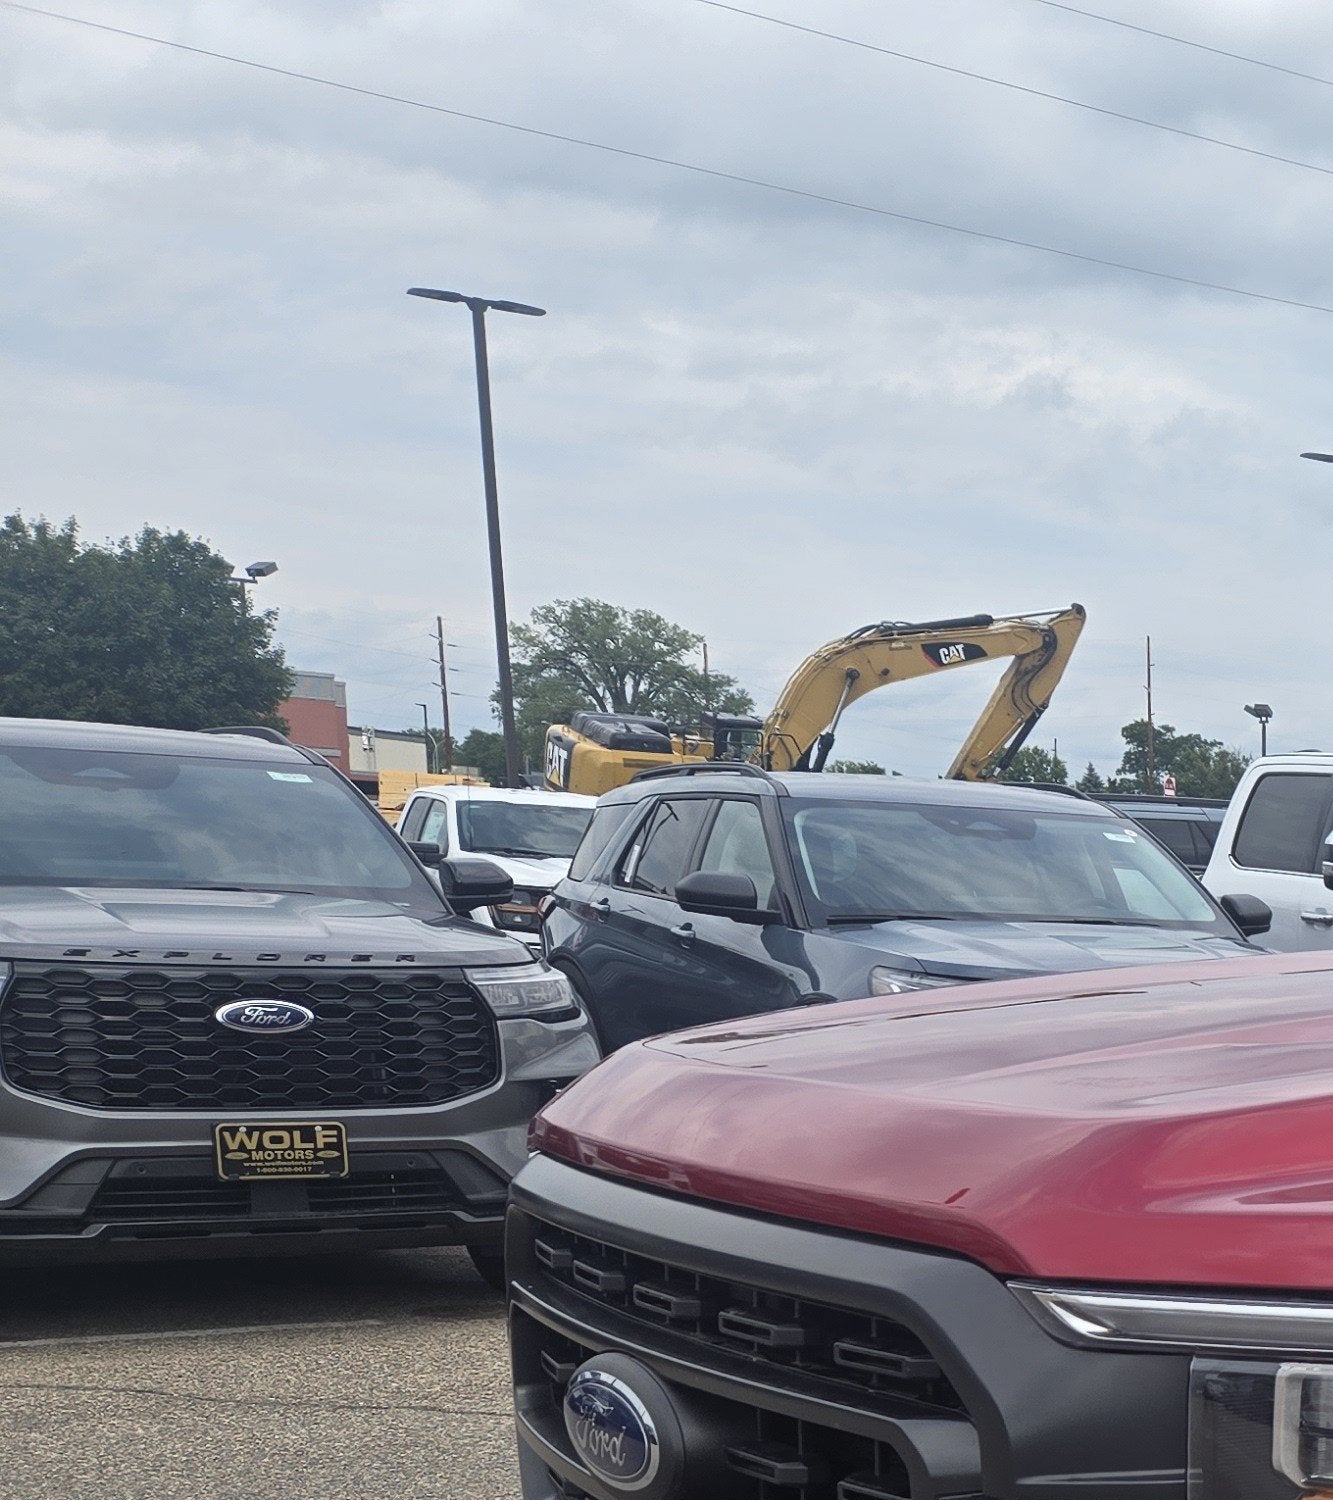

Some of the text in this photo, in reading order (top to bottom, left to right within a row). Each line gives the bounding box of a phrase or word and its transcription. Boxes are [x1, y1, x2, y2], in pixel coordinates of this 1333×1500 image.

[939, 644, 966, 664] CAT
[546, 741, 568, 788] CAT
[62, 948, 416, 963] EXPLORER
[240, 1006, 292, 1026] Ford
[222, 1129, 338, 1150] WOLF
[251, 1149, 315, 1161] MOTORS
[576, 1393, 627, 1467] Ford
